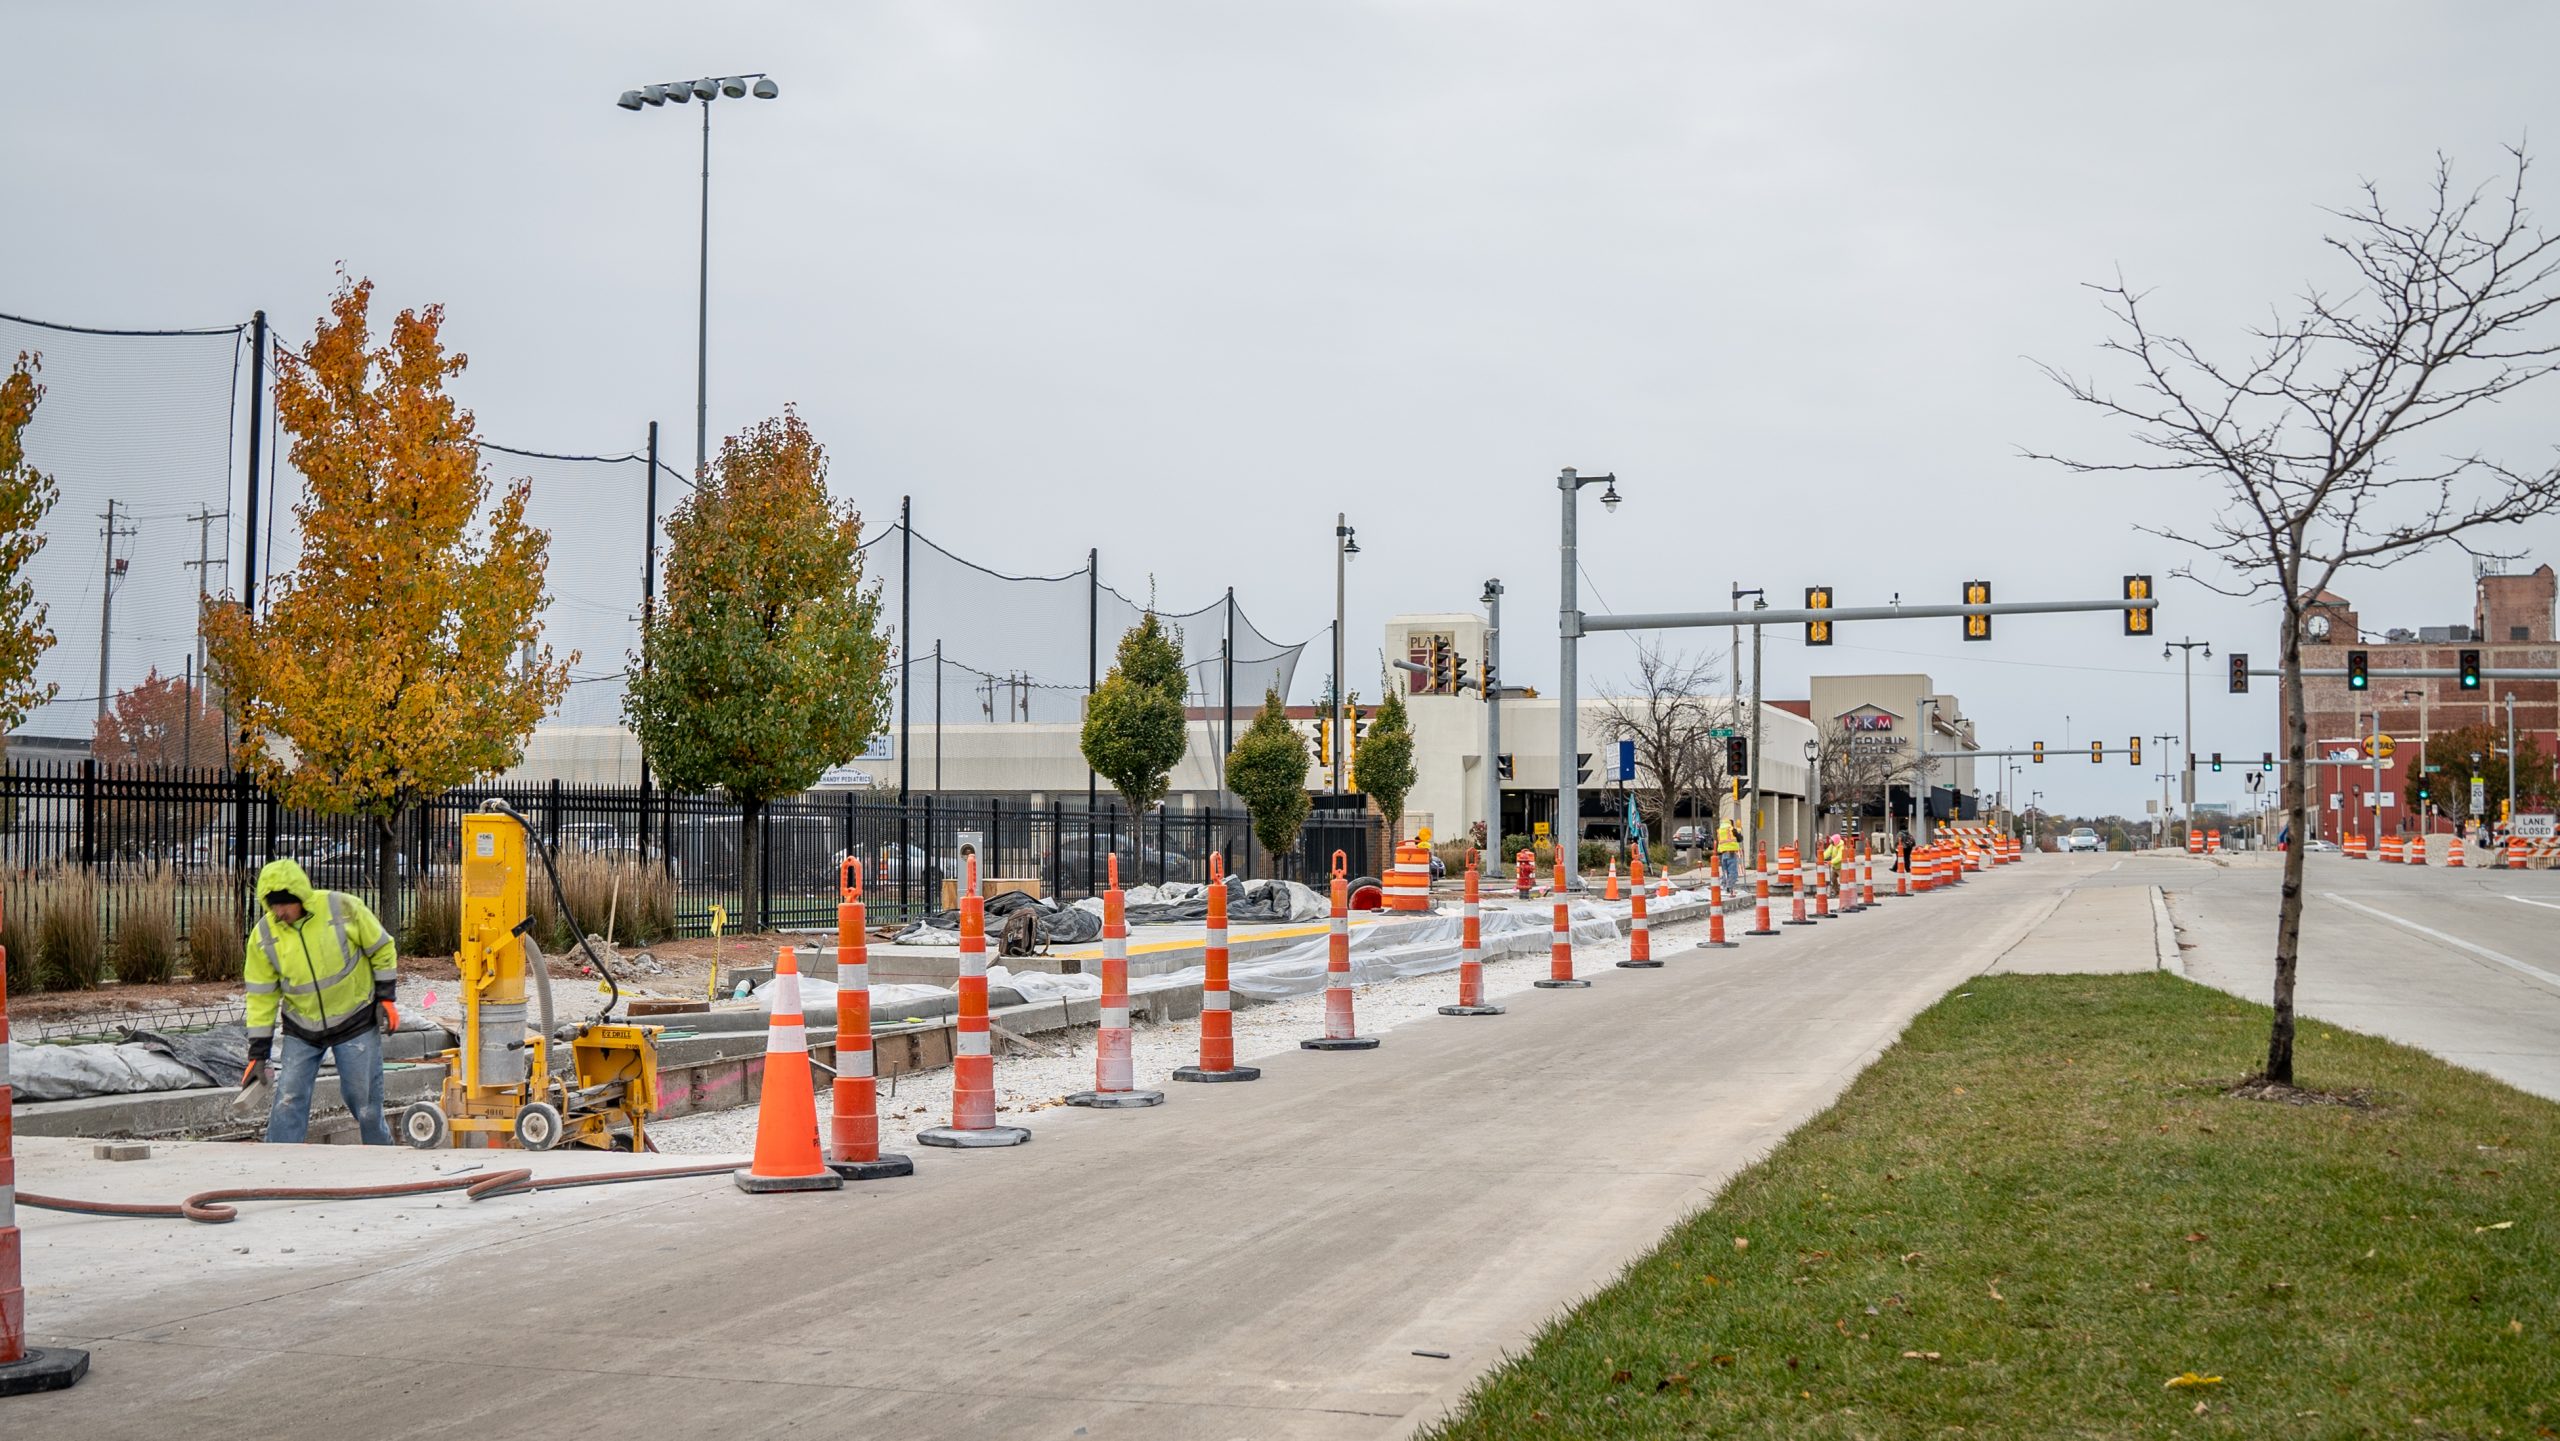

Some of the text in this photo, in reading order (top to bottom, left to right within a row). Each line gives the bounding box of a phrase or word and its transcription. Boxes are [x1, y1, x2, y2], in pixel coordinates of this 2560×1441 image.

[1410, 636, 1451, 648] PLAA
[2366, 742, 2395, 750] MDAS
[2522, 818, 2546, 826] LANE
[2517, 826, 2551, 835] CLOSED
